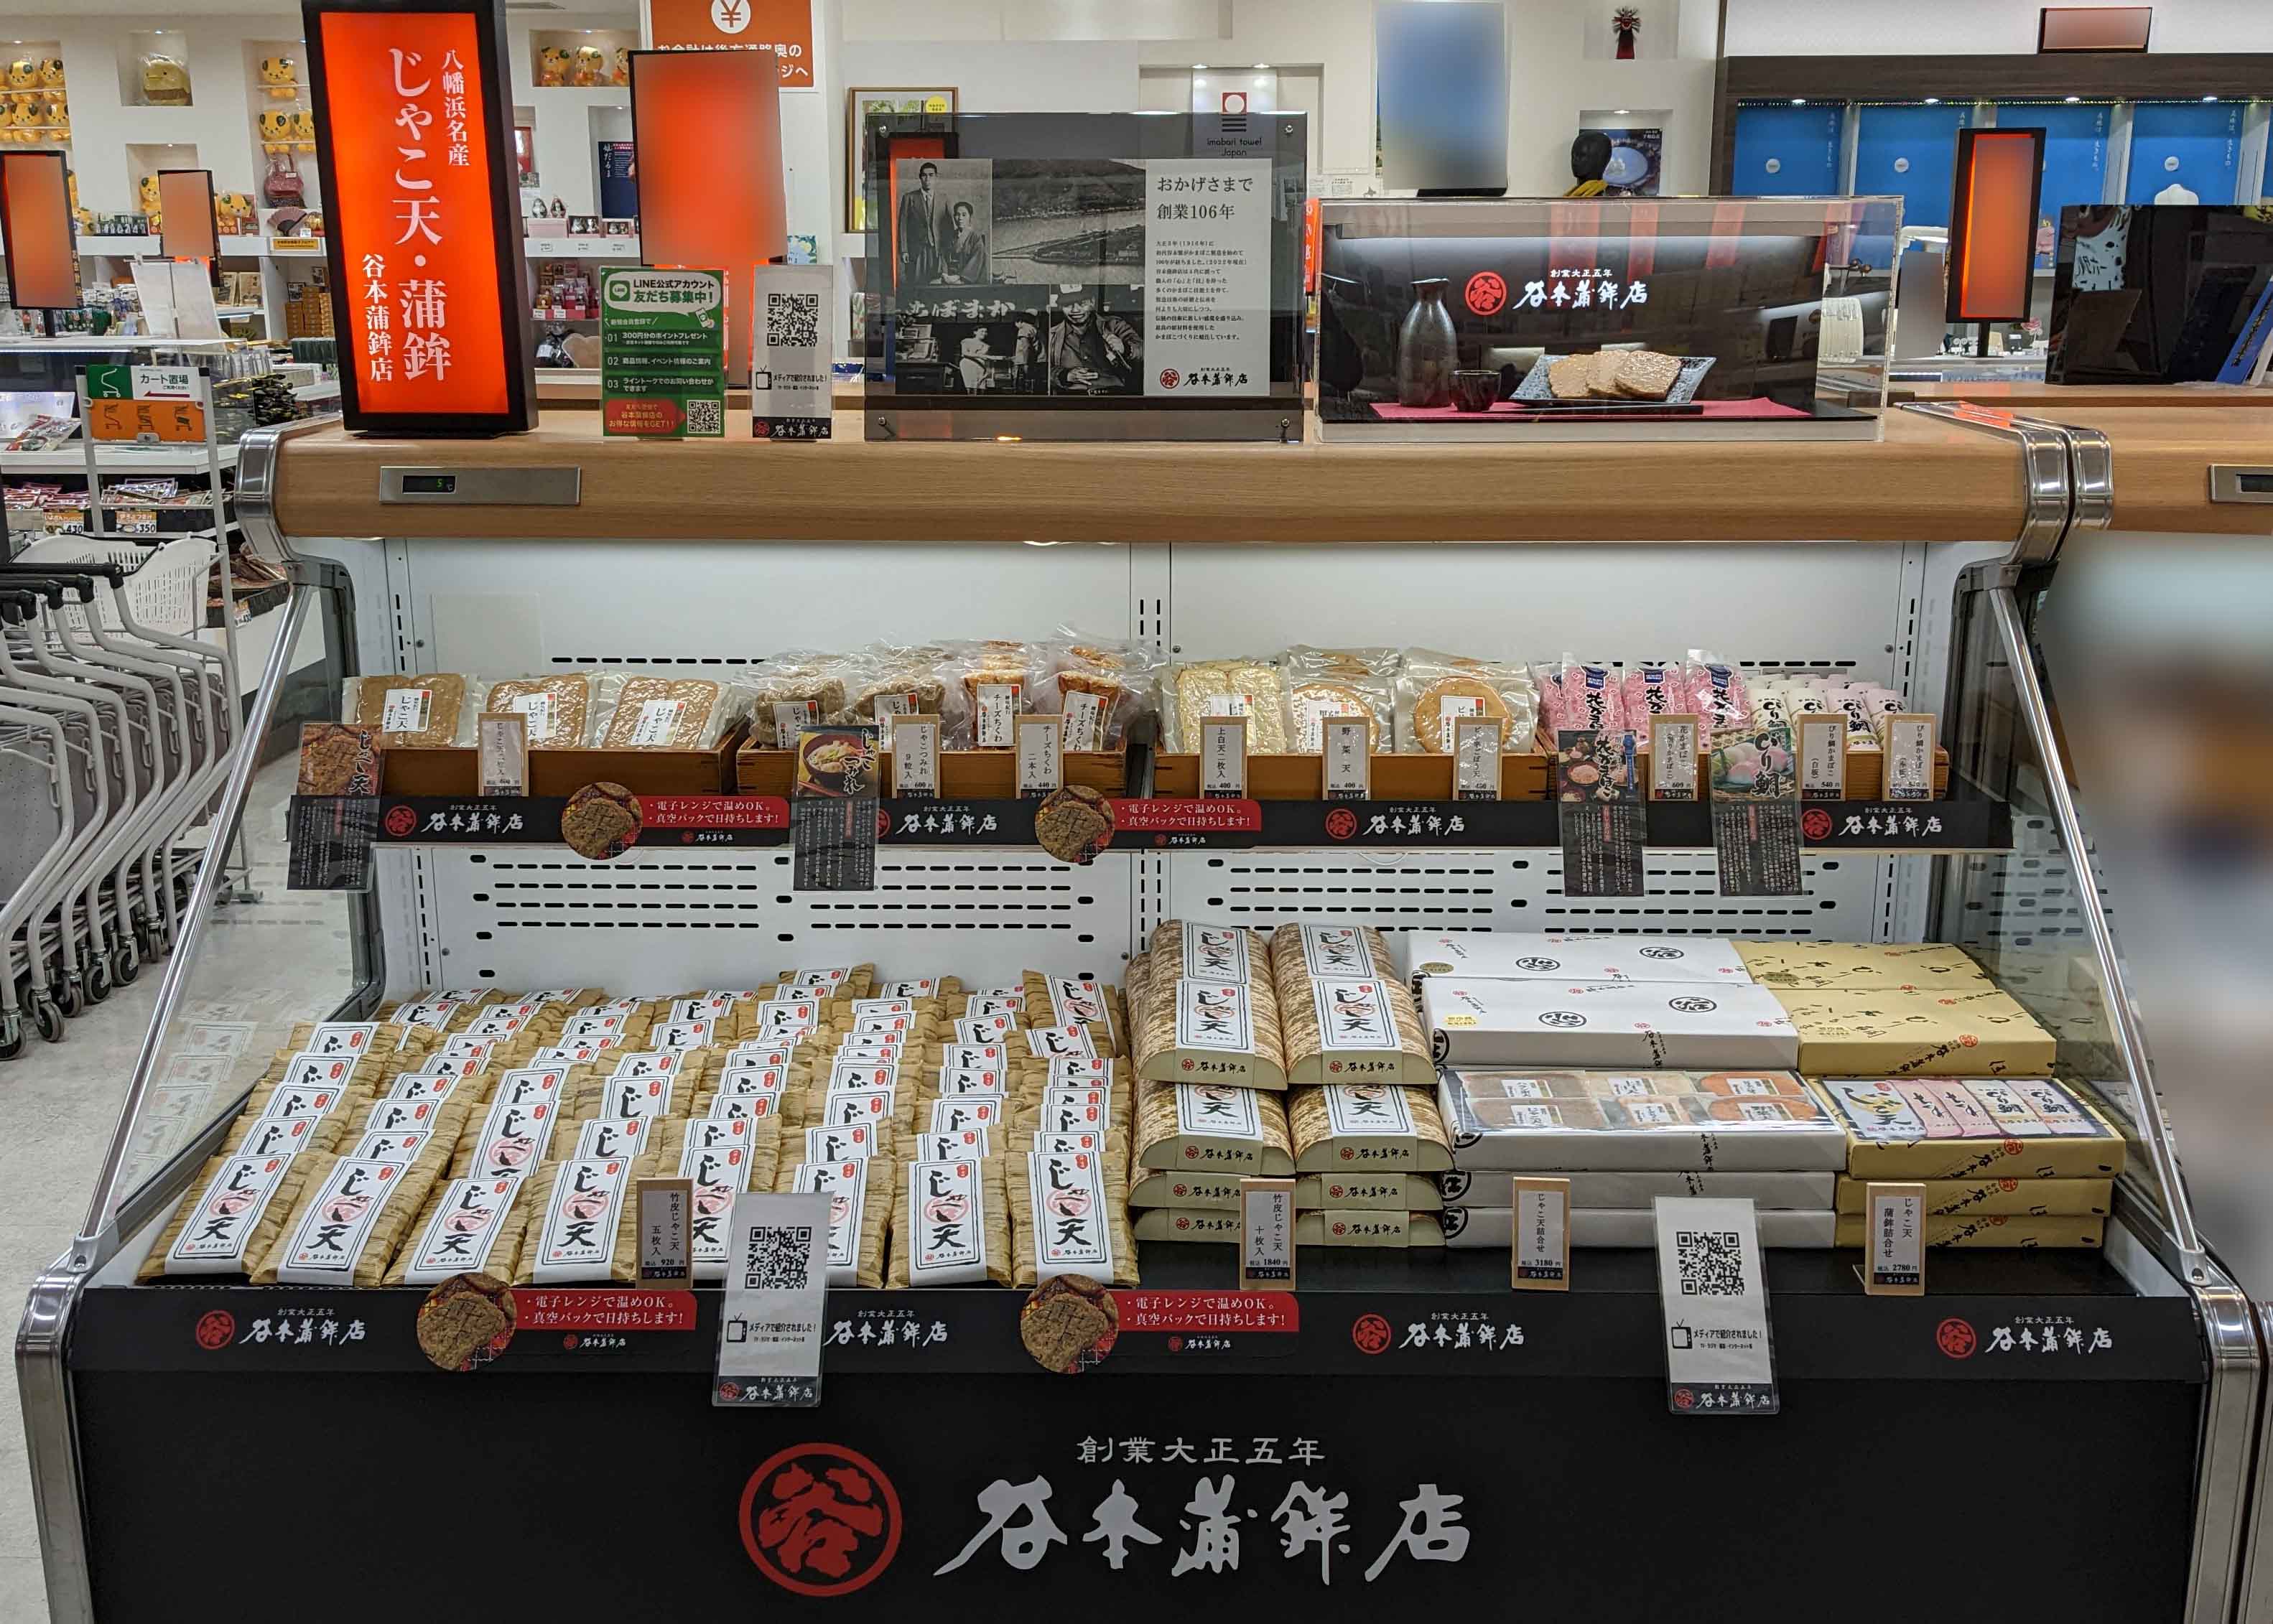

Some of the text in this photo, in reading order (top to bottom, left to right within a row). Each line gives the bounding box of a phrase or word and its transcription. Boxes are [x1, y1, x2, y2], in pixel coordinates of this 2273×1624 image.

[442, 50, 470, 167] 八幡浜名産
[1158, 177, 1254, 192] おかげさまで
[389, 48, 451, 381] じゃこ天・蒲鉾
[1156, 204, 1235, 219] 創業106年
[633, 279, 715, 289] LINE公式アカウント
[1551, 269, 1613, 278] 創業大正五年
[633, 291, 713, 303] 友だち募集中！
[1512, 279, 1647, 309] 谷本蒲鉾店
[362, 254, 394, 381] 谷本蒲鉾店
[608, 334, 618, 342] 01
[140, 373, 189, 385] カート置場
[1184, 373, 1247, 386] 谷本蒲鉾店
[993, 694, 1003, 742] チーズちくわ
[919, 725, 928, 775] じゃこつみれ
[1043, 726, 1052, 775] チーズちくわ
[1217, 727, 1226, 778] 上白天二枚入
[1342, 727, 1351, 773] 野菜天
[843, 757, 865, 795] つみれ
[1028, 753, 1037, 779] 二本入
[421, 813, 524, 833] 谷本蒲鉾店
[896, 814, 998, 834] 谷本蒲鉾店
[1363, 816, 1464, 836] 谷本蒲鉾店
[1839, 816, 1943, 836] 谷本蒲鉾店
[1197, 1060, 1247, 1073] 谷本蒲鉾店
[1344, 1061, 1395, 1073] 谷本蒲鉾店
[1201, 1147, 1252, 1161] 谷本蒲鉾店
[1357, 1147, 1409, 1160] 谷本蒲鉾店
[202, 1164, 259, 1241] じゃこ天
[692, 1154, 735, 1244] じゃこ天
[1049, 1159, 1092, 1246] じゃこ天
[1189, 1185, 1240, 1198] 谷本蒲鉾
[1349, 1185, 1398, 1198] 谷本蒲鉾店
[306, 1167, 374, 1251] じゃこ天
[432, 1185, 493, 1254] じゃこ天
[561, 1165, 610, 1247] じゃこ天
[928, 1170, 967, 1249] じゃこ天
[1902, 1198, 1913, 1238] じゃこ天
[670, 1193, 680, 1251] 竹皮じゃこ天
[1192, 1218, 1240, 1231] 谷本蒲鉾
[1273, 1193, 1283, 1251] 竹皮じゃこ天
[1348, 1223, 1400, 1236] 谷本蒲鉾店
[1536, 1193, 1545, 1252] じゃこ天詰合せ
[1883, 1208, 1895, 1258] 蒲鉾詰合せ
[651, 1226, 661, 1256] 五枚入
[1254, 1226, 1264, 1256] 十枚入
[278, 1308, 335, 1317] 創業大正五年
[2014, 1316, 2074, 1325] 創業大正五年
[240, 1317, 365, 1345] 谷本蒲鉾店
[749, 1323, 816, 1333] メディアで紹介されました！
[822, 1320, 948, 1347] 谷本蒲鉾店
[1399, 1323, 1524, 1350] 谷本蒲鉾店
[1693, 1330, 1762, 1339] メディアで紹介されました！
[1984, 1327, 2112, 1353] 谷本蒲鉾店
[740, 1384, 813, 1401] 谷本蒲鉾店
[1696, 1392, 1770, 1409] 谷本蒲鉾店
[1077, 1437, 1325, 1465] 創業大正五年
[933, 1474, 1471, 1585] 谷本蒲鉾店
